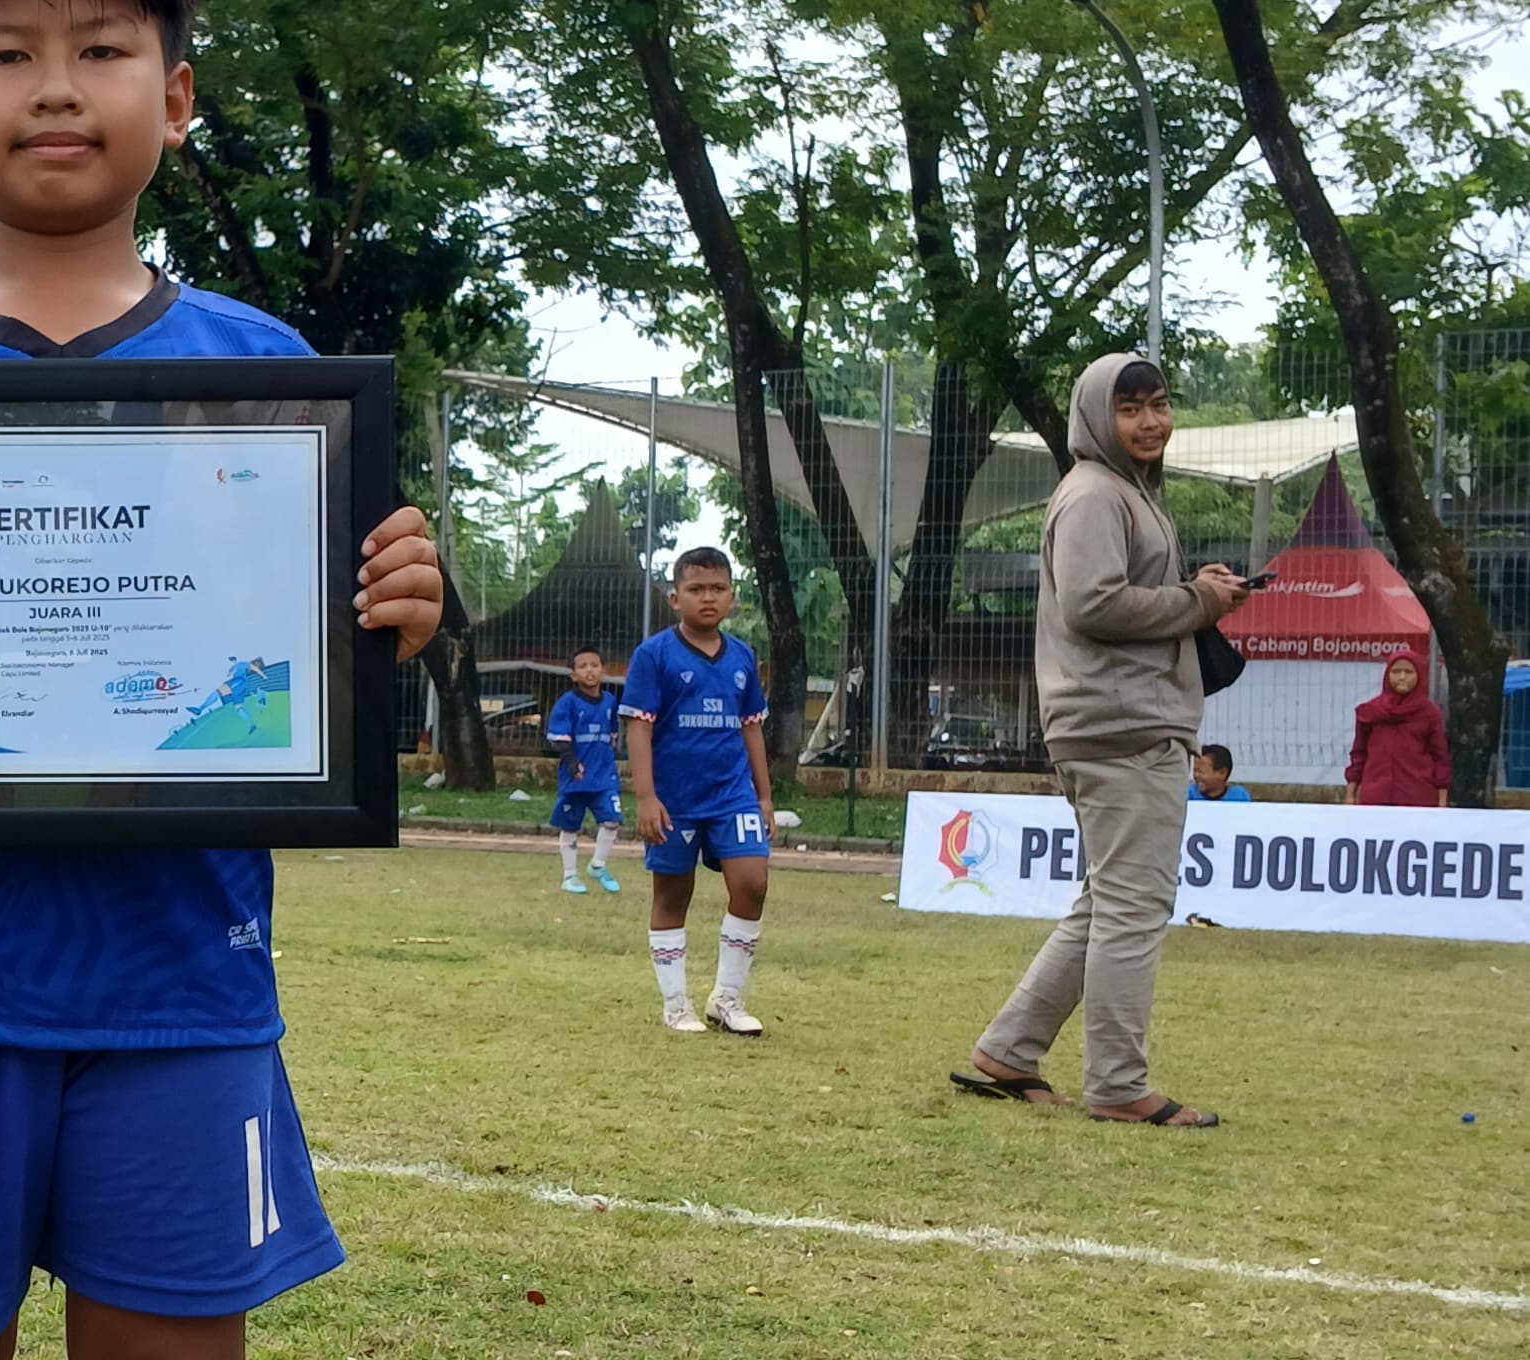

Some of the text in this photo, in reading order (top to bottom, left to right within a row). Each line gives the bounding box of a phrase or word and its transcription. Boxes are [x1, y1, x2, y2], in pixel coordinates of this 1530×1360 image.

[117, 574, 197, 593] PUTRA
[28, 606, 101, 619] JUARA III
[92, 633, 110, 642] 2025
[1246, 636, 1308, 656] Cabang
[1313, 636, 1411, 656] Bojonegoro
[90, 648, 108, 656] 2025
[735, 813, 763, 844] 19
[1019, 826, 1525, 902] PES DOLOKGEDE
